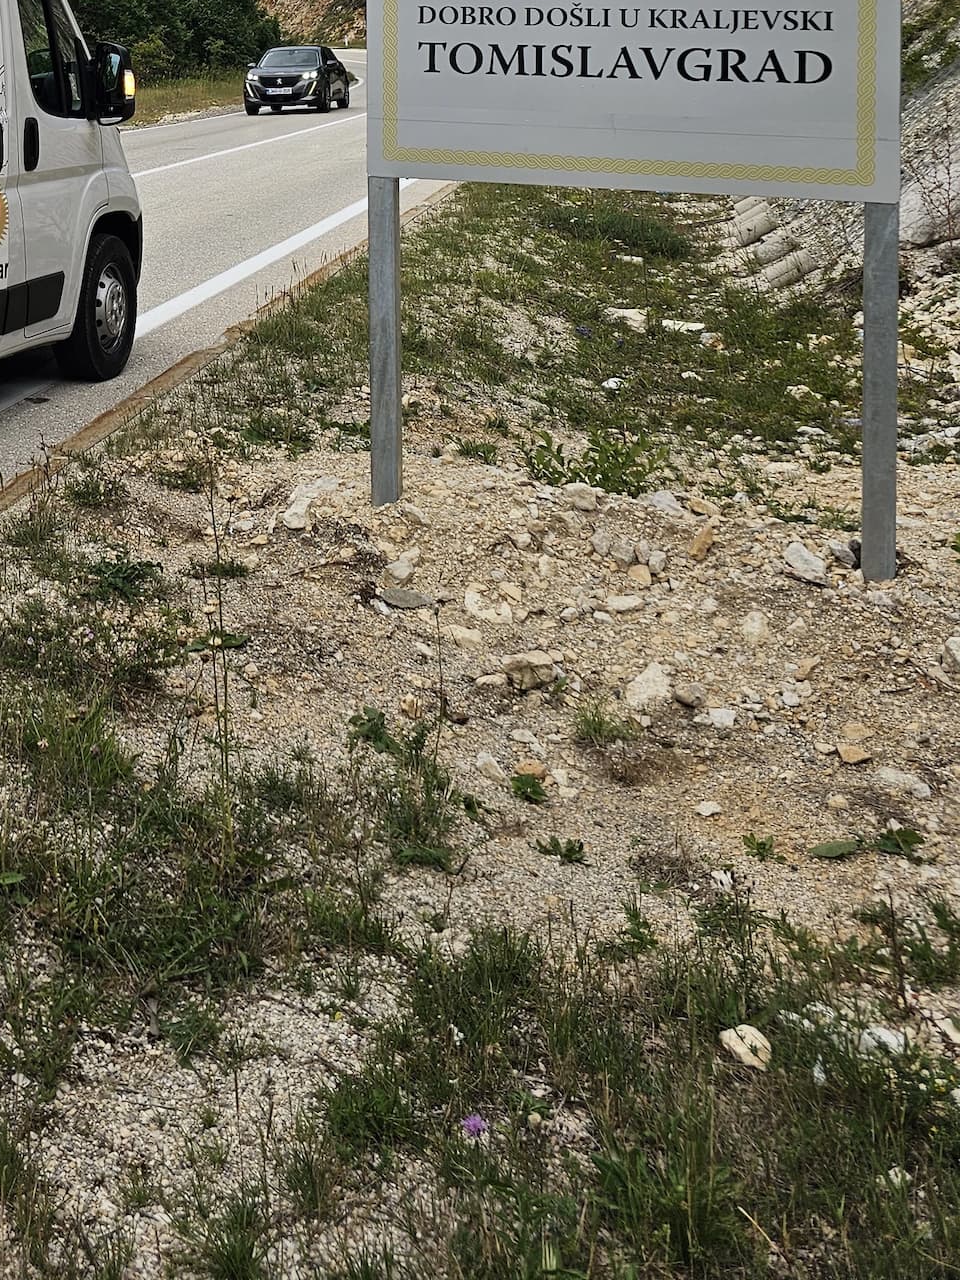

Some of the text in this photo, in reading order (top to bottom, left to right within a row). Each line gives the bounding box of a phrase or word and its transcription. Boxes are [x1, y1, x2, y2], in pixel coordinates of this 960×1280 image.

[418, 2, 834, 34] DOBRO DOŠLI U KRALJEVSKI
[418, 41, 833, 84] TOMISLAVGRAD
